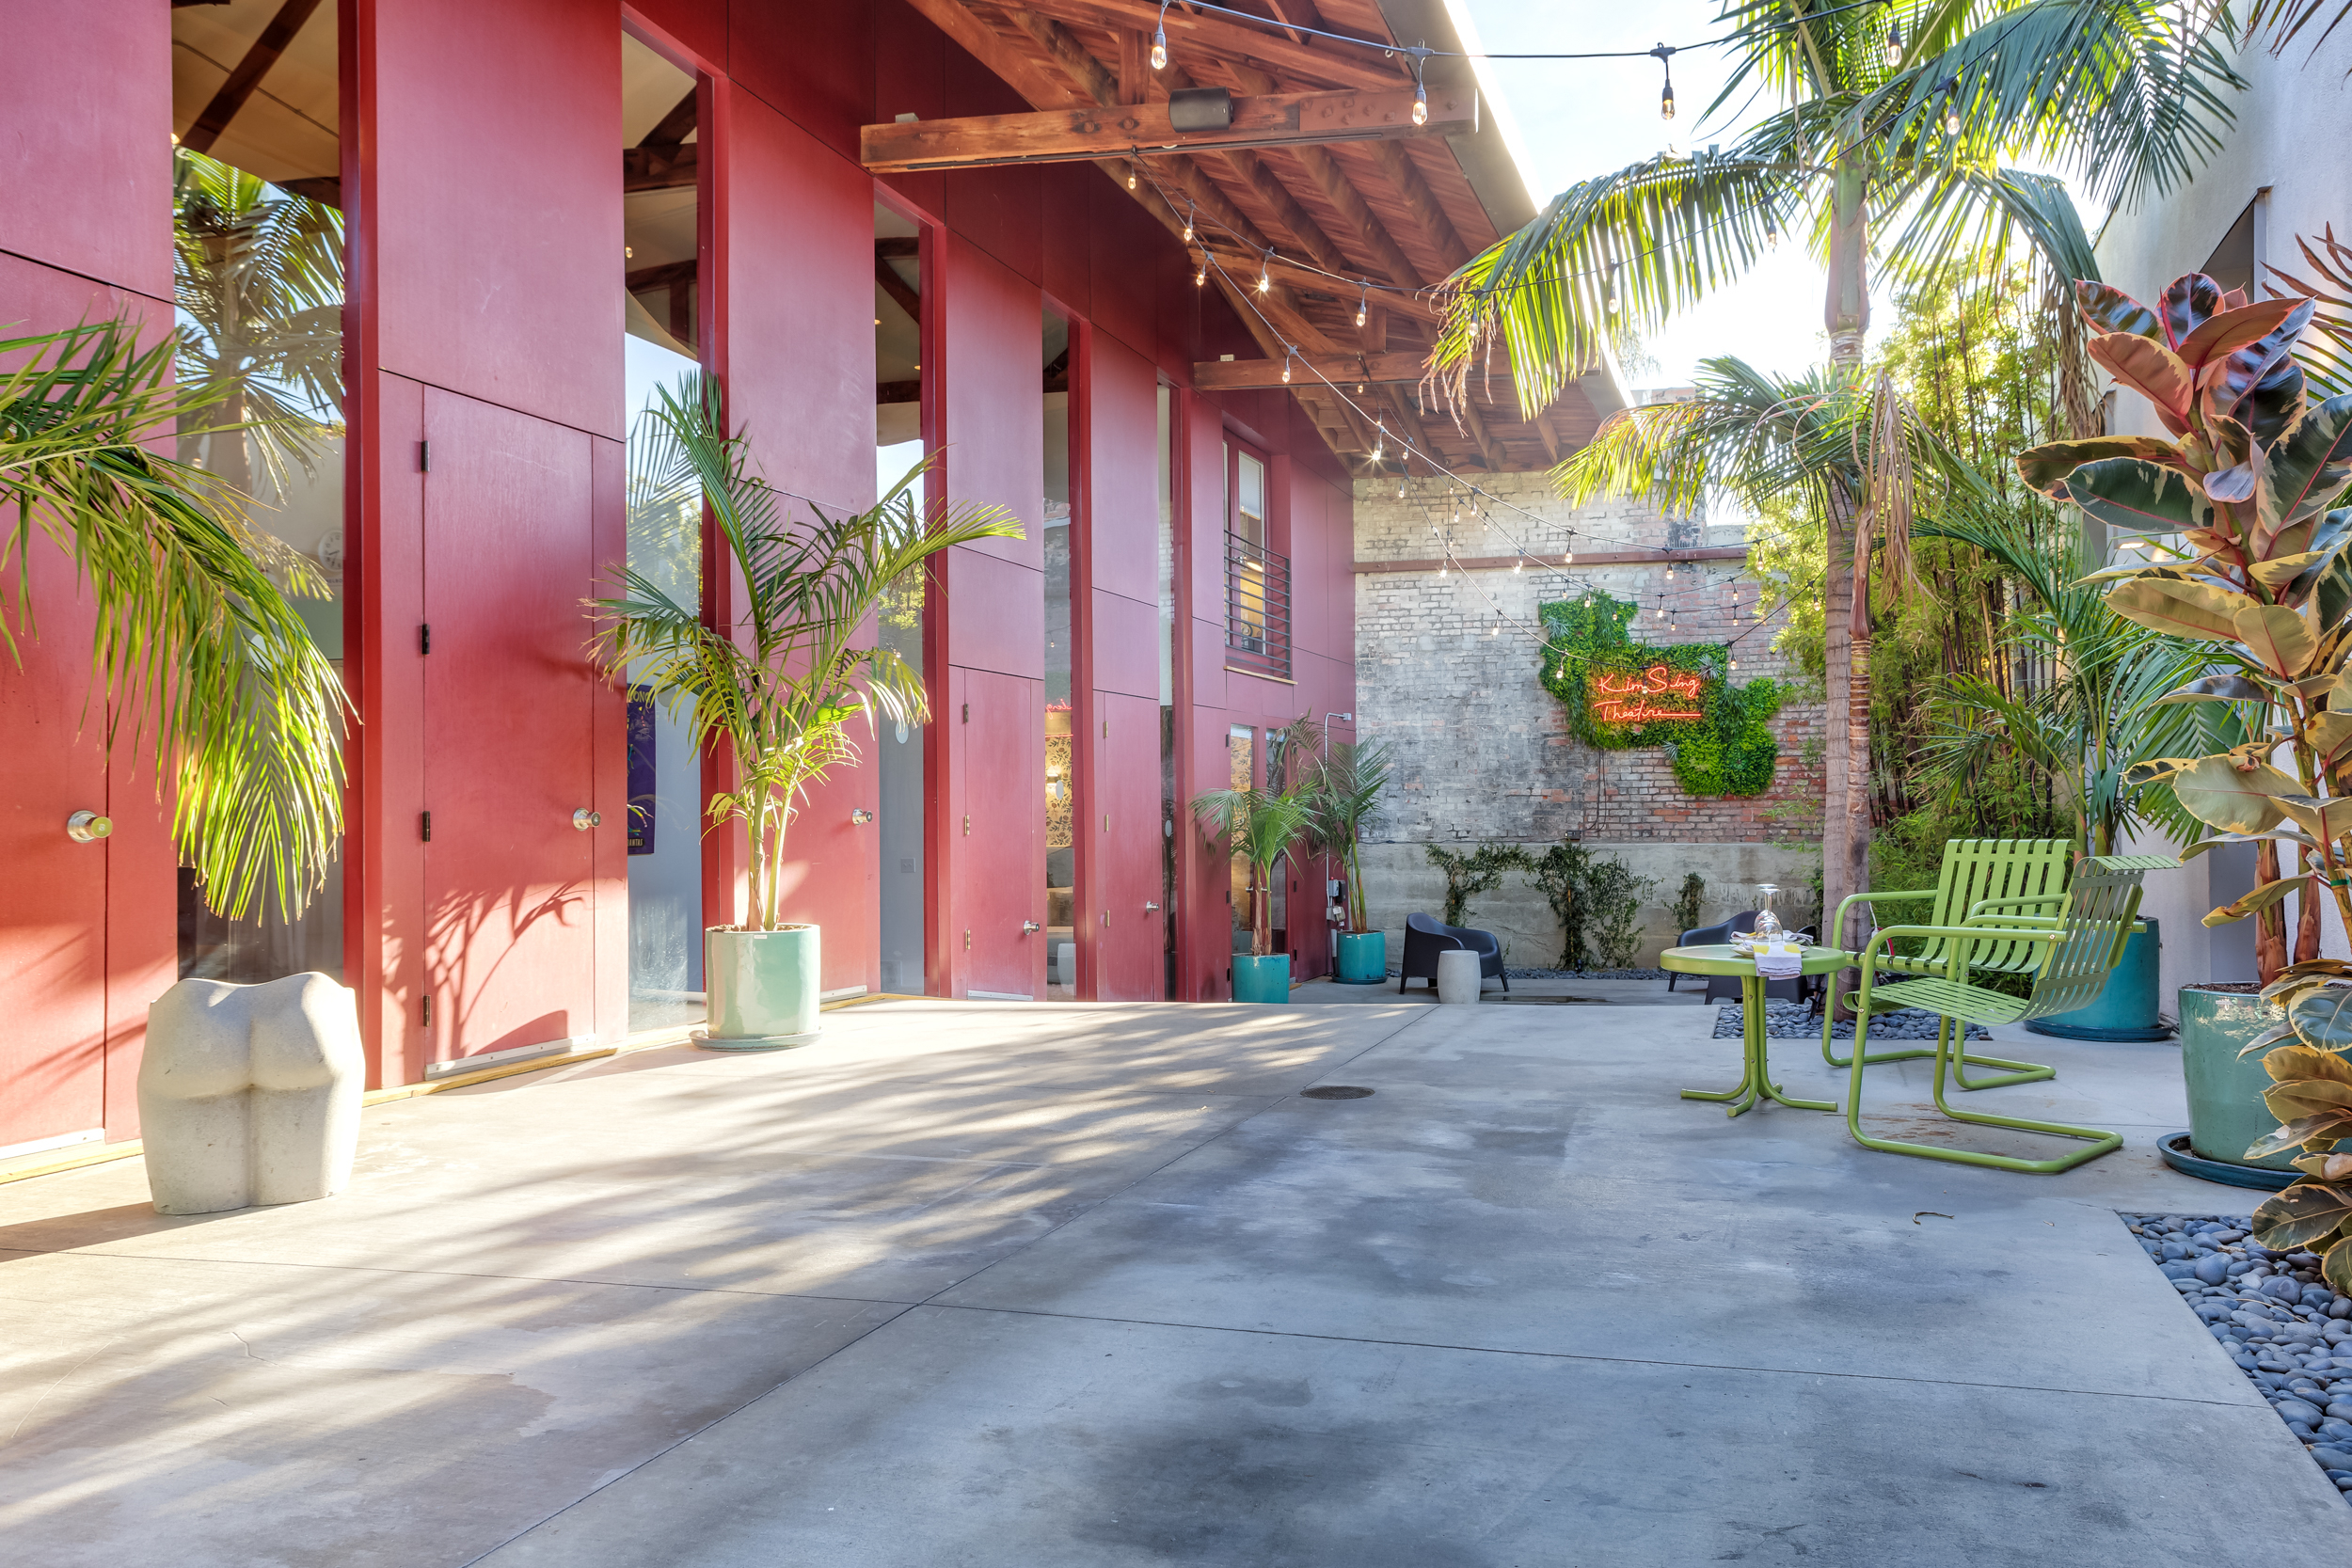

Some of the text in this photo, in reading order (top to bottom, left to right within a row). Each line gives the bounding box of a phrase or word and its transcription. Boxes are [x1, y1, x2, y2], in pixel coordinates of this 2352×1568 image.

[1598, 666, 1700, 698] Kim Sing
[628, 690, 651, 704] ONG
[1594, 699, 1701, 721] Theatre
[628, 838, 643, 847] ANTAS
